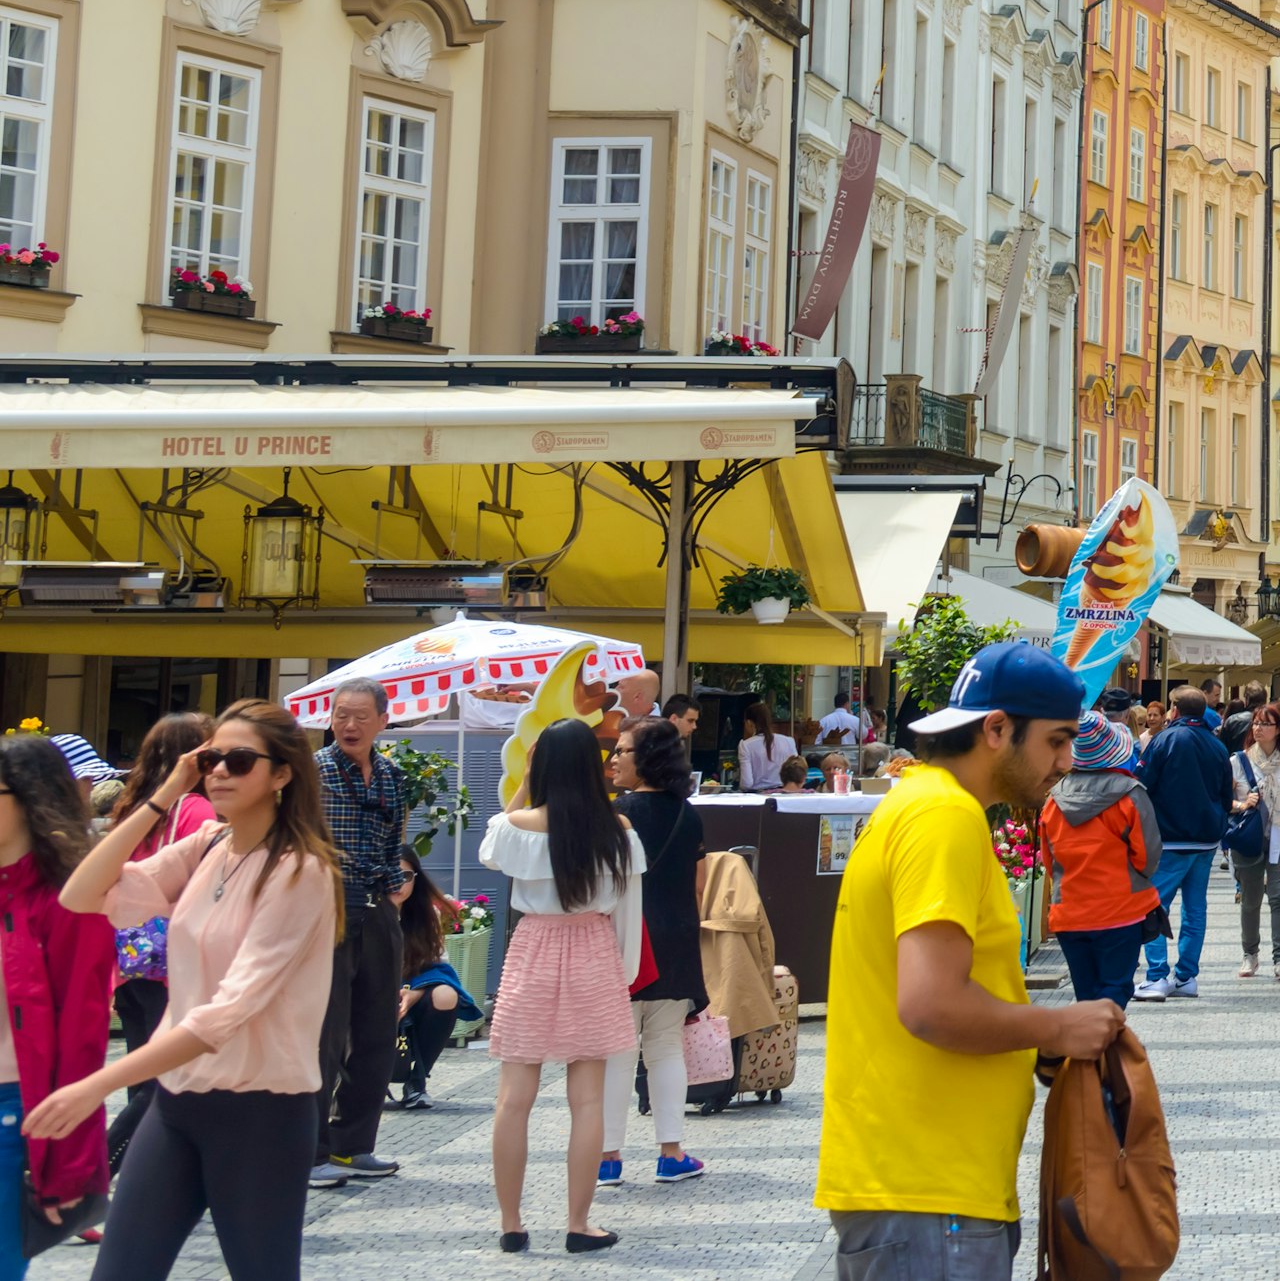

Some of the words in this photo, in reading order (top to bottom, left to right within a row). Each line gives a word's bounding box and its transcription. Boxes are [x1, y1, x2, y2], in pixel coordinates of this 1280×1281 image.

[801, 283, 822, 320] DŮM
[162, 437, 225, 456] HOTEL
[235, 436, 248, 455] U
[257, 435, 331, 455] PRINCE
[1066, 608, 1135, 621] ZMRZLINA
